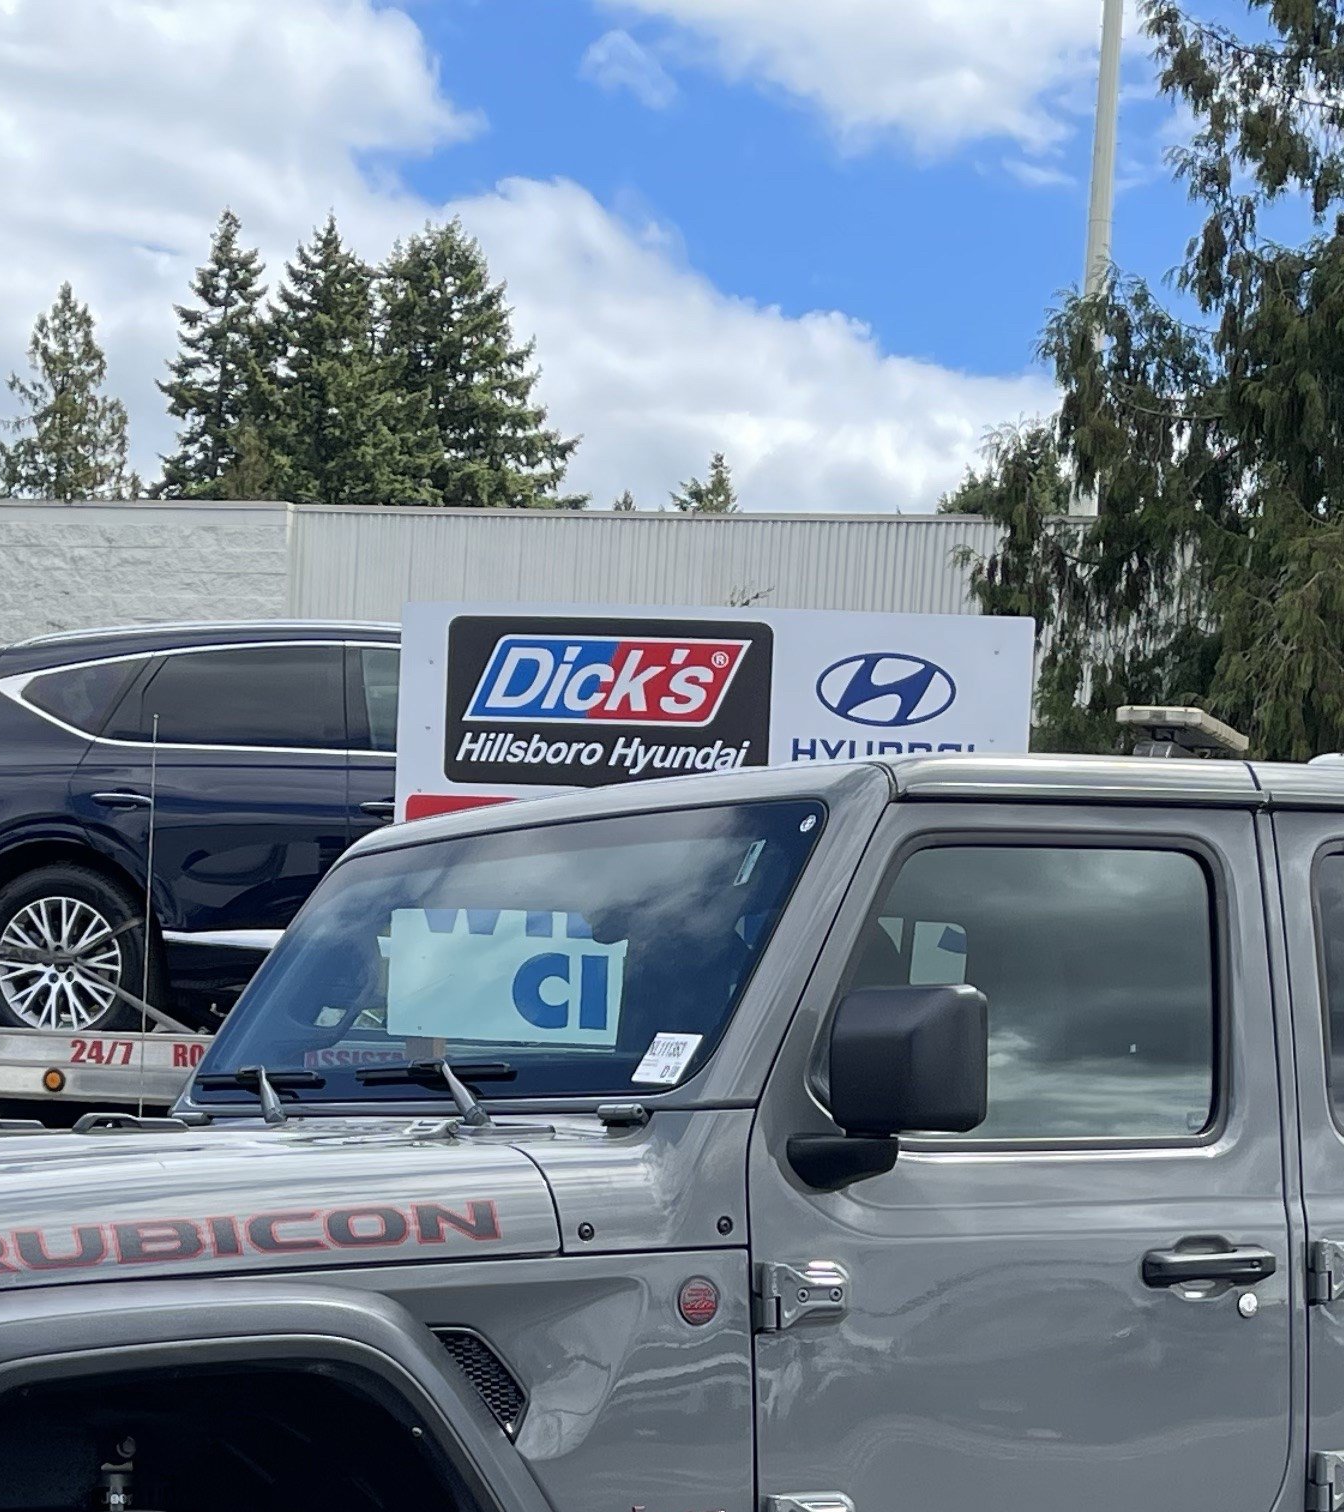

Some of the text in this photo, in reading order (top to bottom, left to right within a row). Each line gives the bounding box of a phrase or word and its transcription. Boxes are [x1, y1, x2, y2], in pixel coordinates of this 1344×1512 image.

[485, 645, 715, 714] Dick's
[456, 731, 751, 775] Hillsboro Hyundai
[513, 952, 609, 1030] CI
[70, 1039, 133, 1065] 24/7
[173, 1044, 205, 1067] RO
